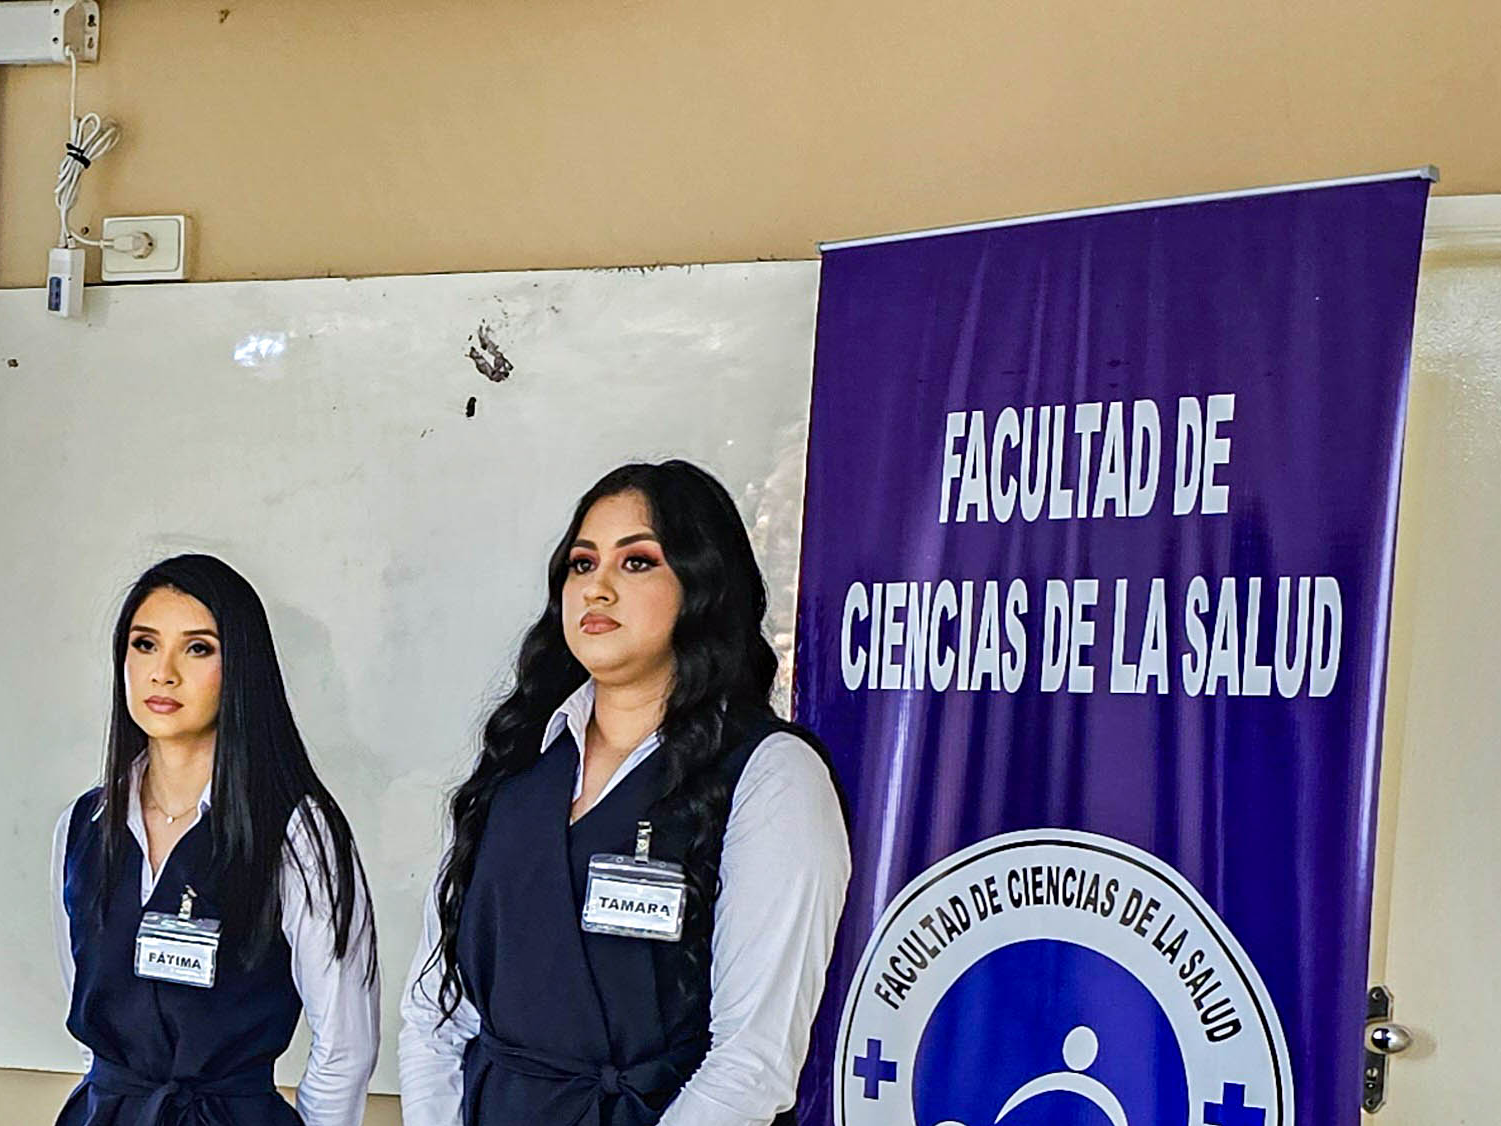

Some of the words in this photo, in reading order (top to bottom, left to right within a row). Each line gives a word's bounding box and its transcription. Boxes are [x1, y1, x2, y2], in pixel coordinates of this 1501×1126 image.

[939, 399, 1161, 523] FACULTAD
[1173, 394, 1236, 516] DE
[841, 578, 1029, 694] CIENCIAS
[1040, 578, 1099, 693] DE
[1110, 578, 1169, 694] LA
[1181, 576, 1343, 698] SALUD
[148, 951, 202, 970] FÁTIMA
[598, 896, 671, 917] TAMARA
[874, 895, 972, 1010] FACULTAD
[970, 876, 1003, 921] DE
[1007, 865, 1120, 918] CIENCIAS
[1119, 880, 1161, 938] DE
[1151, 915, 1192, 966] LA
[1179, 949, 1243, 1045] SALUD
